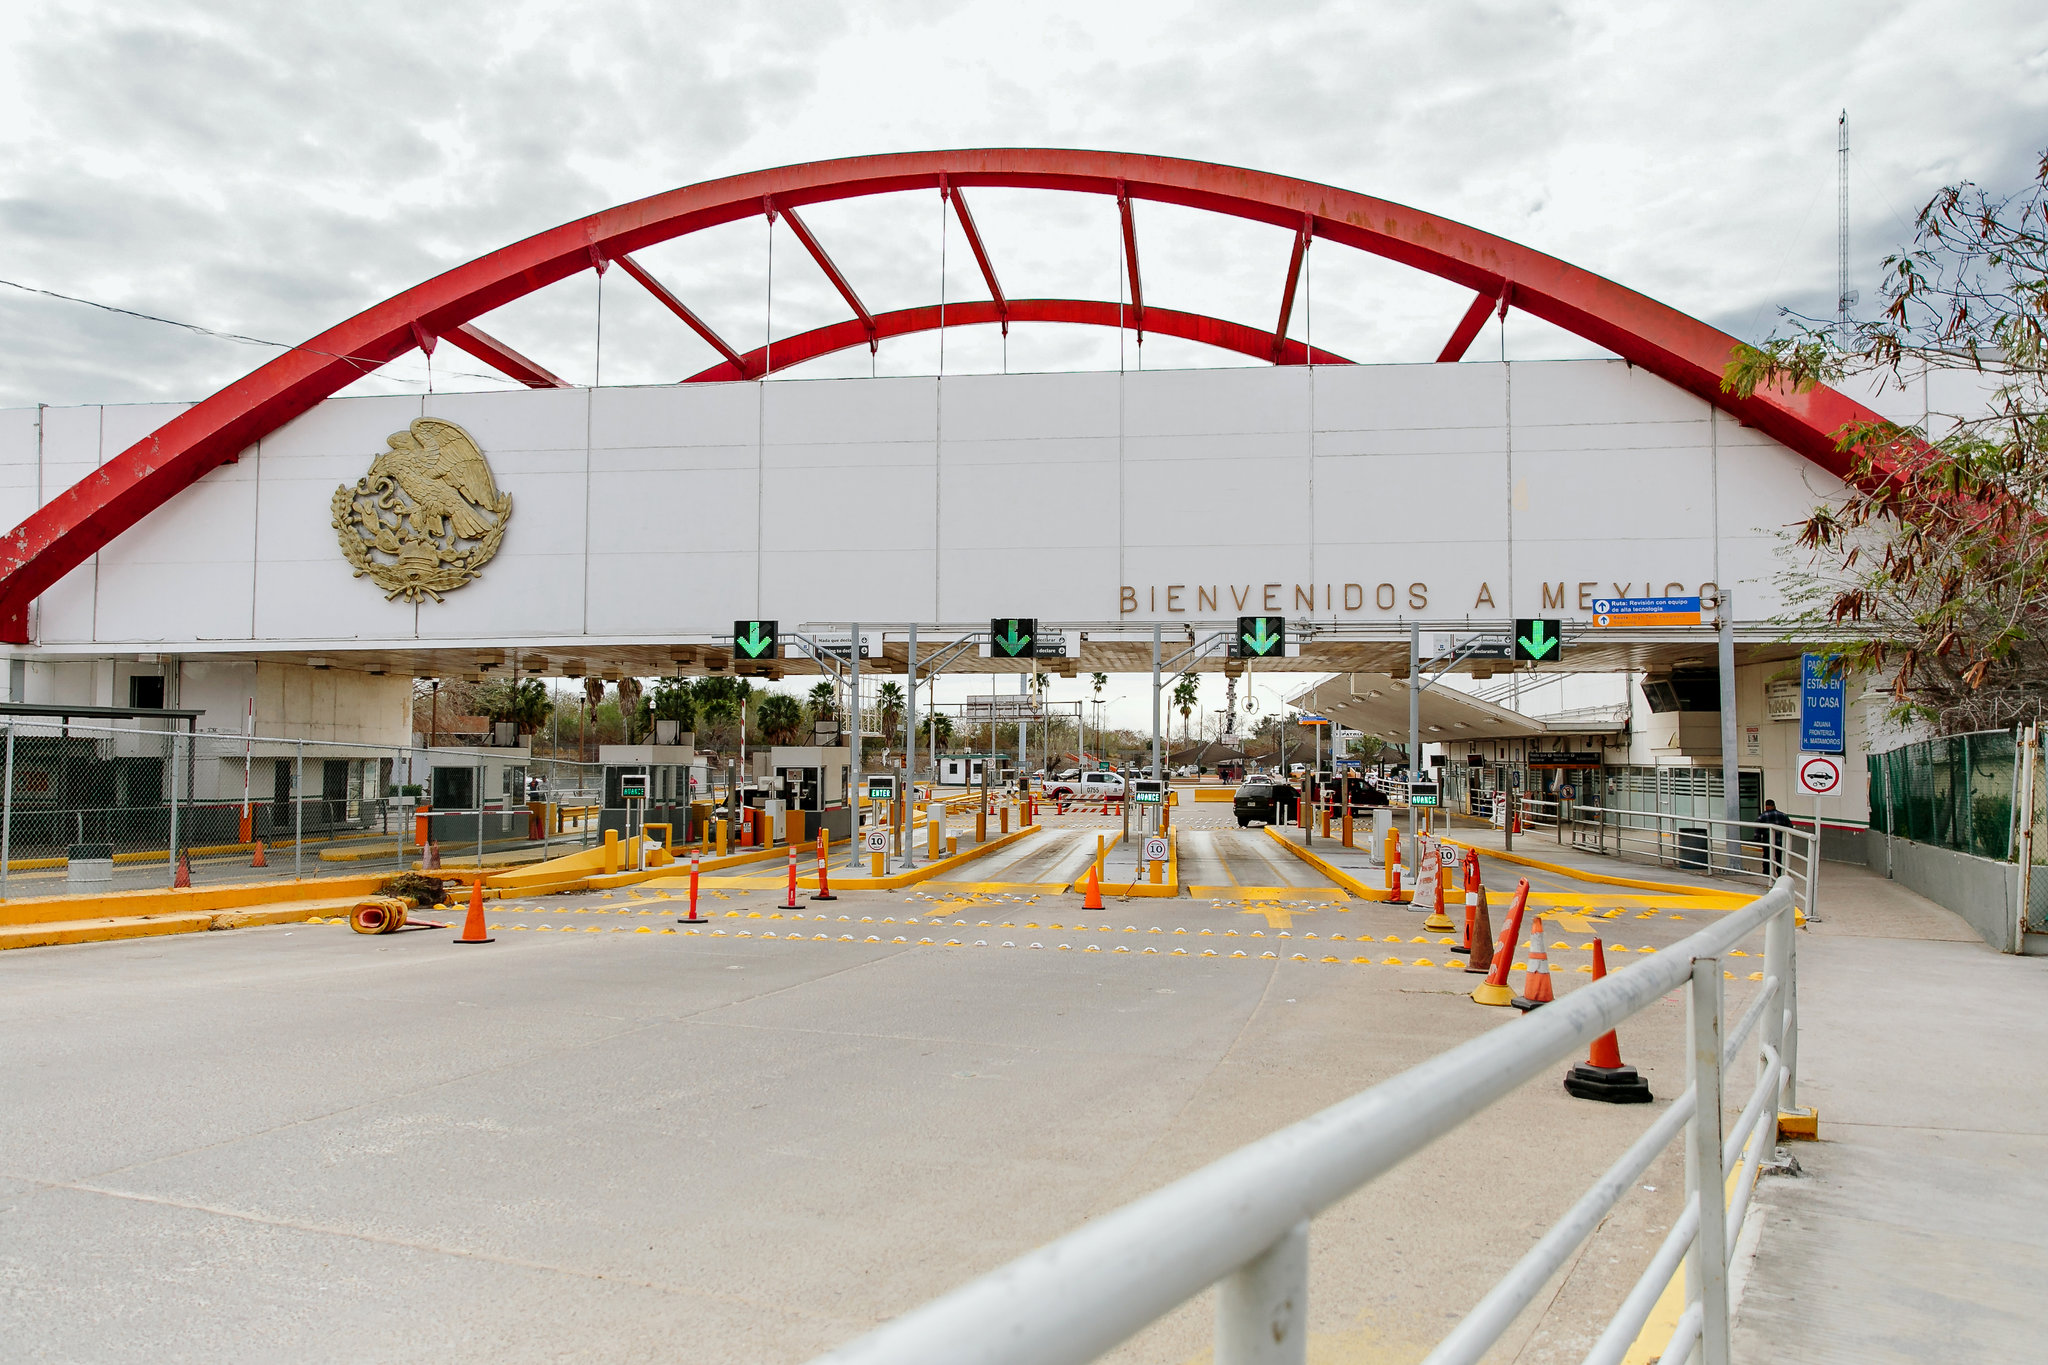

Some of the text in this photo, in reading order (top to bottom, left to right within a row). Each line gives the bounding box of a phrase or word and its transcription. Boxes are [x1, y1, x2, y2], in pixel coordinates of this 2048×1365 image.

[1120, 582, 1428, 613] BIENVENIDOS
[1475, 582, 1495, 609] A
[1830, 678, 1840, 690] EN
[1807, 696, 1817, 708] TU
[1819, 696, 1840, 708] CASA
[1808, 728, 1835, 736] FRONTERIZA
[871, 789, 891, 797] ENTER
[1086, 786, 1100, 794] 0755
[871, 837, 883, 845] 10
[1150, 845, 1163, 854] 10
[1440, 851, 1453, 860] 10
